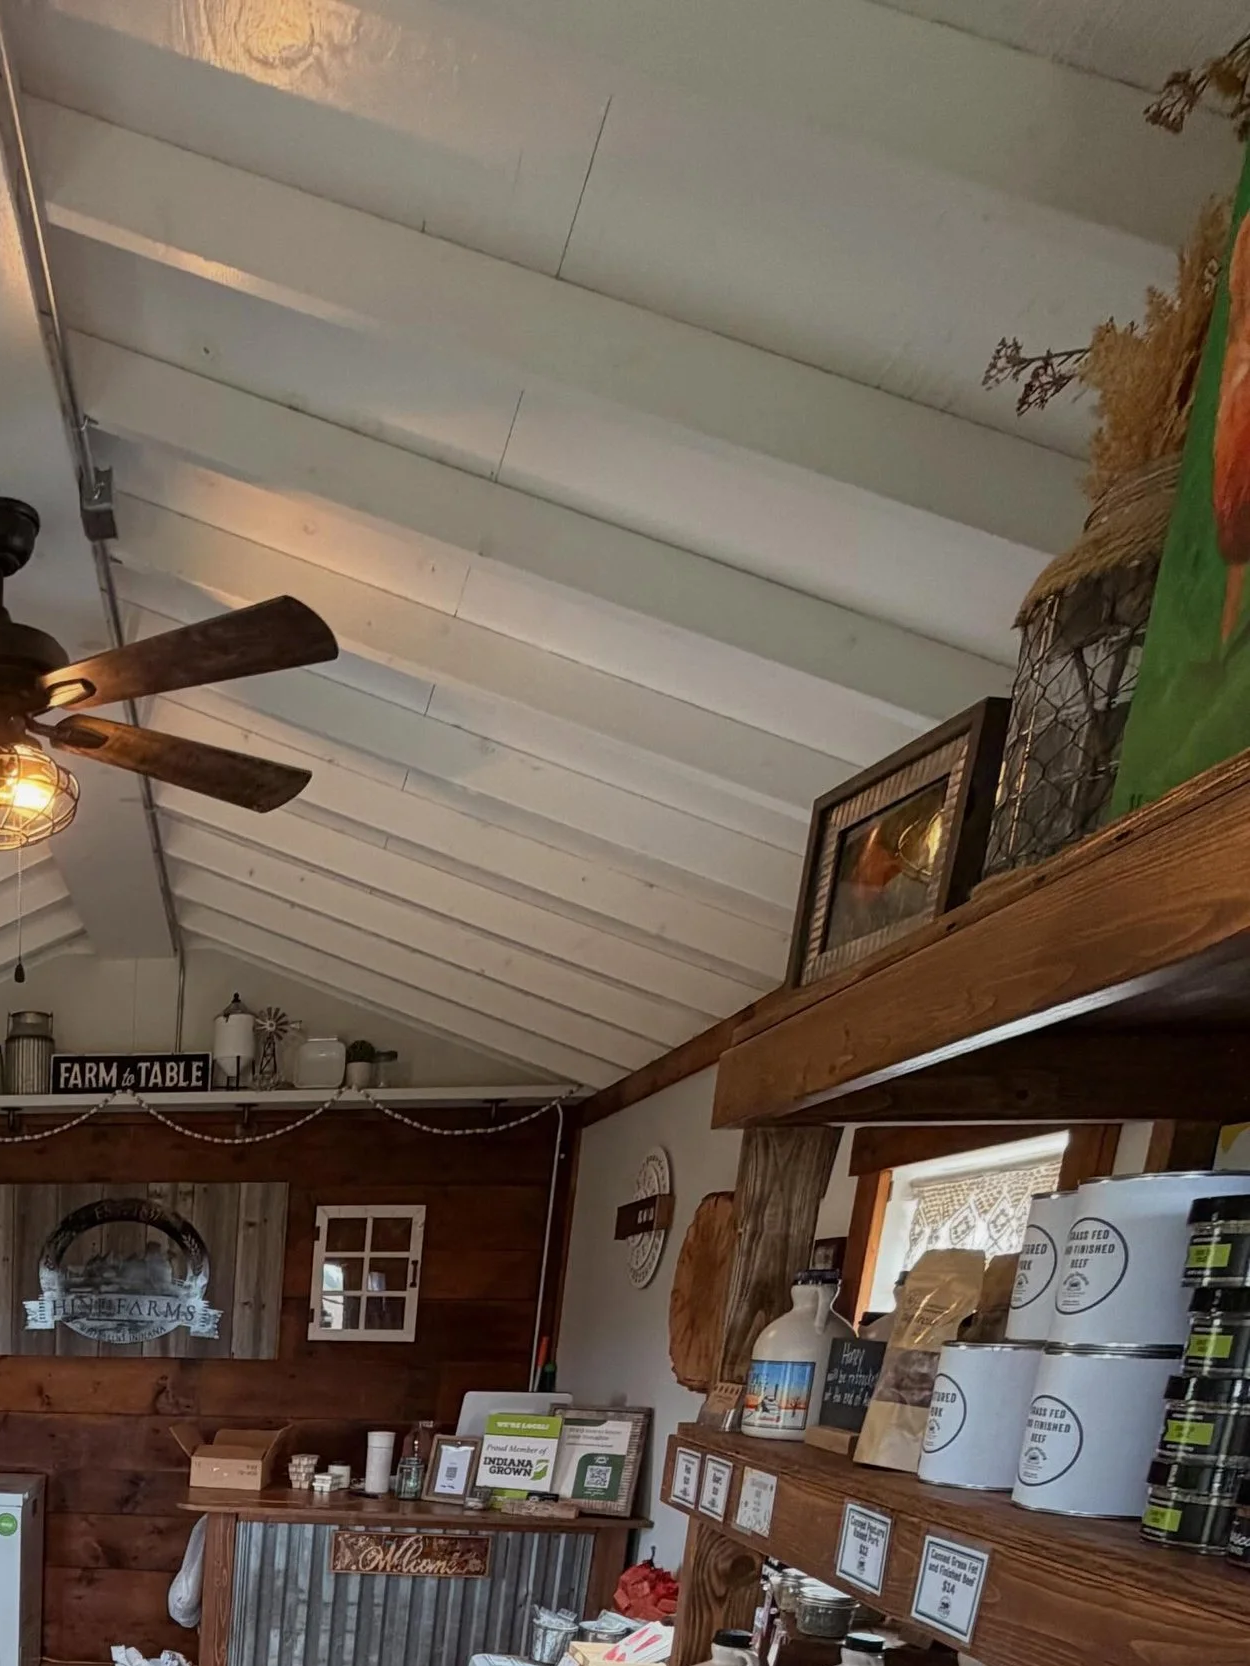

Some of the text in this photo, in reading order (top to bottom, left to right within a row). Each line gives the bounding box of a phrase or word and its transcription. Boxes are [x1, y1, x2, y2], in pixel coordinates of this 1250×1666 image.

[59, 1061, 204, 1089] FARM to TABLE
[1091, 1229, 1110, 1240] FED
[118, 1300, 197, 1322] FARMS
[1049, 1408, 1067, 1420] FED
[487, 1443, 549, 1457] Proud Member of
[483, 1457, 533, 1469] INDIANA
[489, 1465, 532, 1477] GROWN
[359, 1535, 458, 1575] Welcome
[930, 1549, 951, 1564] Canned
[950, 1554, 967, 1570] Grass
